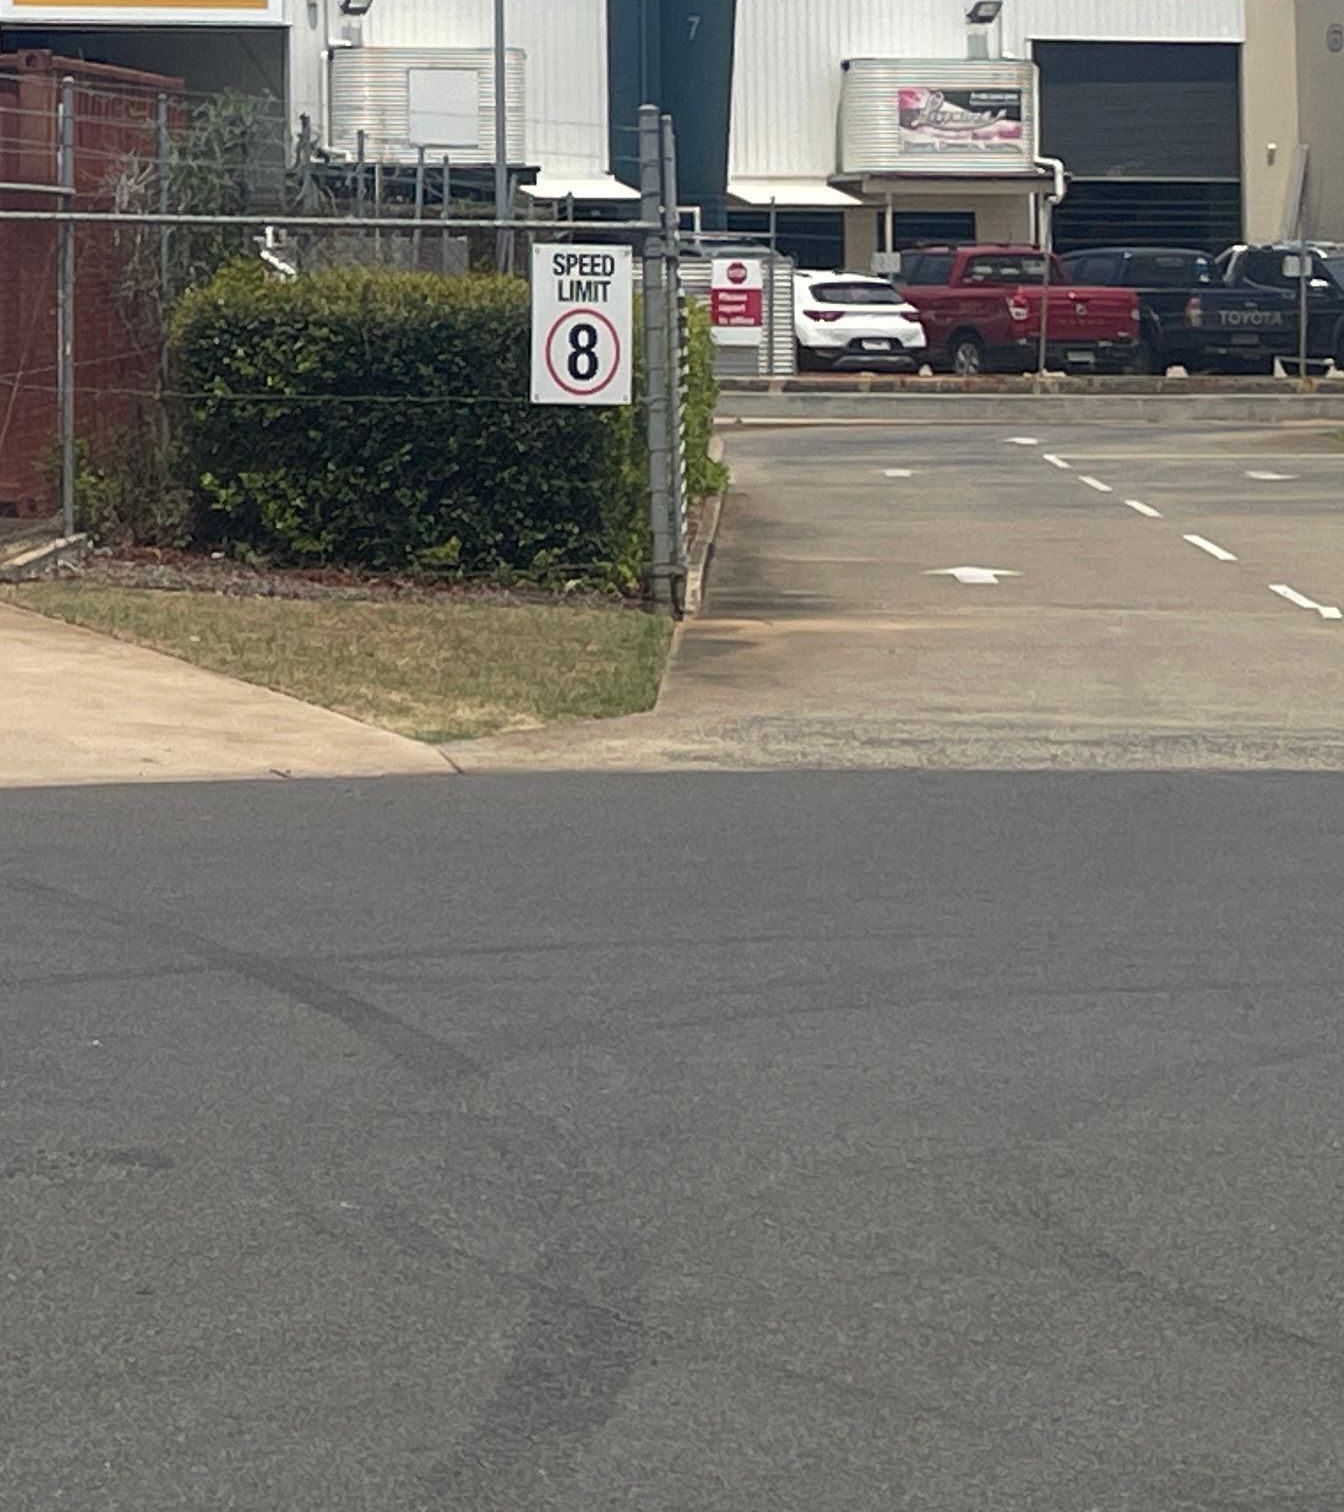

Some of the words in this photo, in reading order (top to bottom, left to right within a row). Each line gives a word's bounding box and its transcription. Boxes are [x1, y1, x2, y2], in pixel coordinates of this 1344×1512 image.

[687, 16, 700, 40] 7
[553, 254, 615, 277] SPEED
[558, 280, 611, 303] LIMIT
[1219, 310, 1283, 326] TOYOTA
[567, 322, 599, 381] 8
